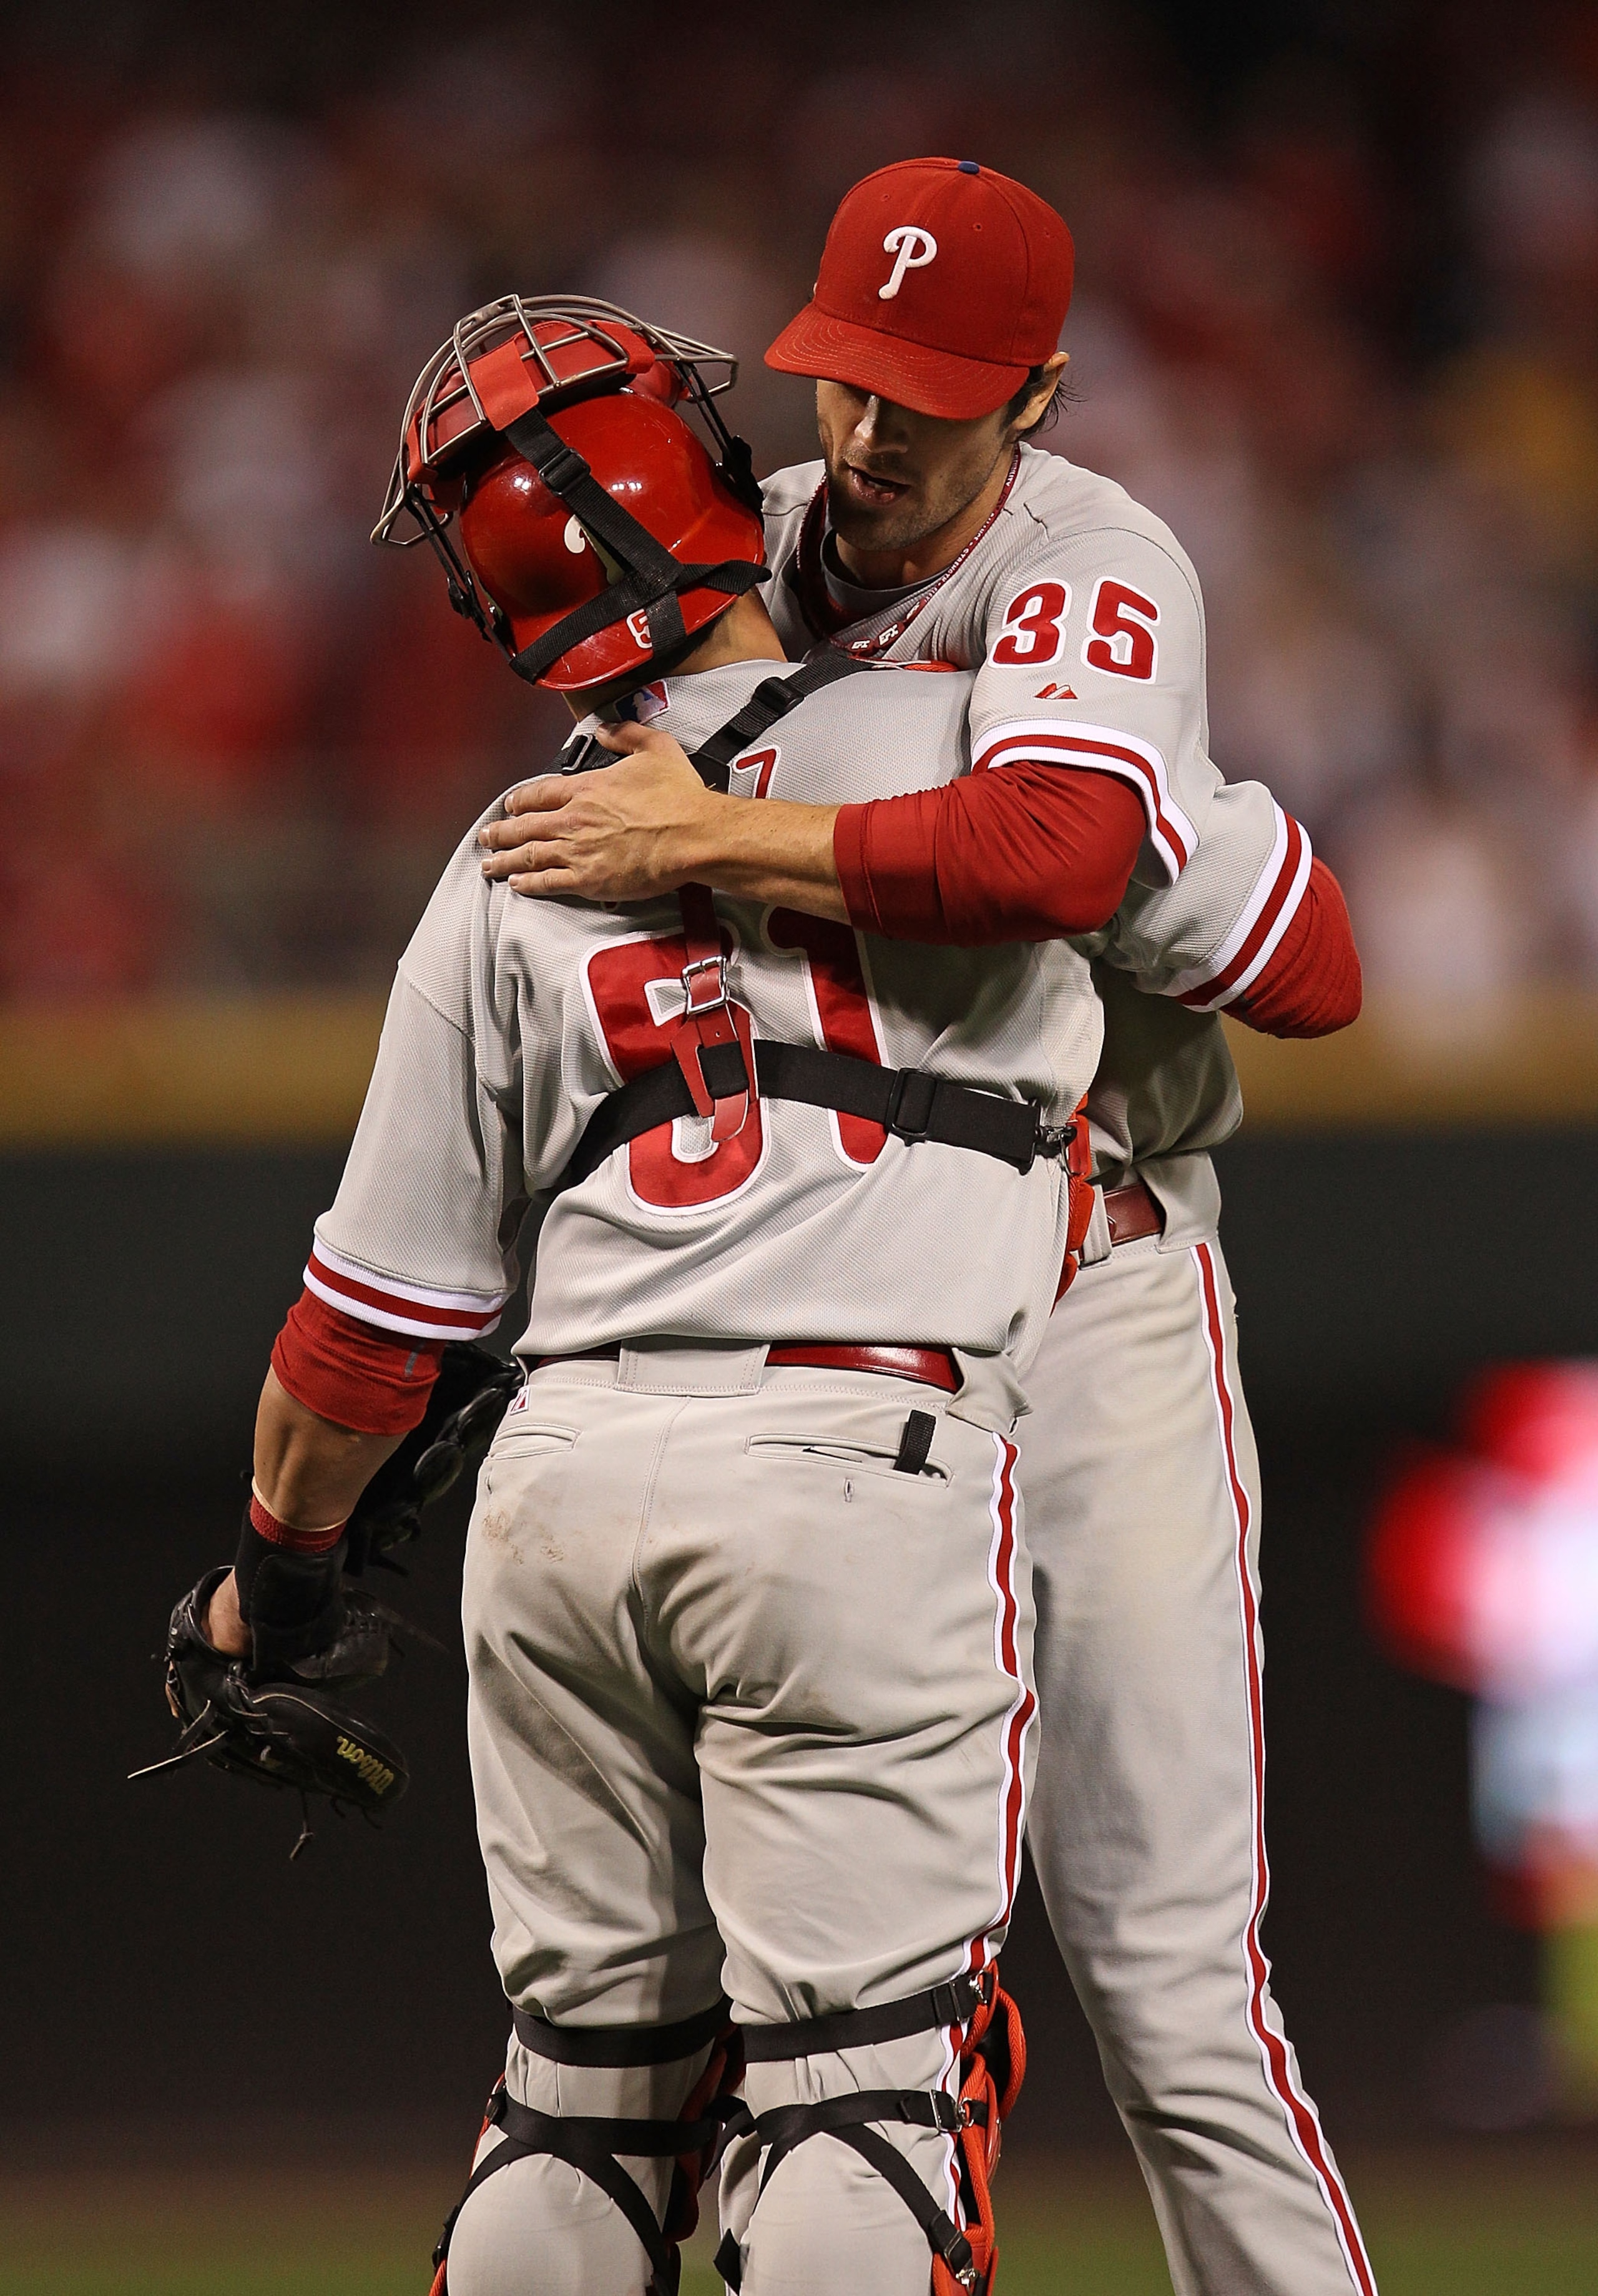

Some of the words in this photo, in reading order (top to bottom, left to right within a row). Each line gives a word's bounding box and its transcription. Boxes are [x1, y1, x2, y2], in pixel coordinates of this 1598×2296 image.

[878, 226, 937, 300] P
[988, 576, 1161, 685] 35
[579, 906, 890, 1216] 51
[336, 1736, 394, 1794] Wilson
